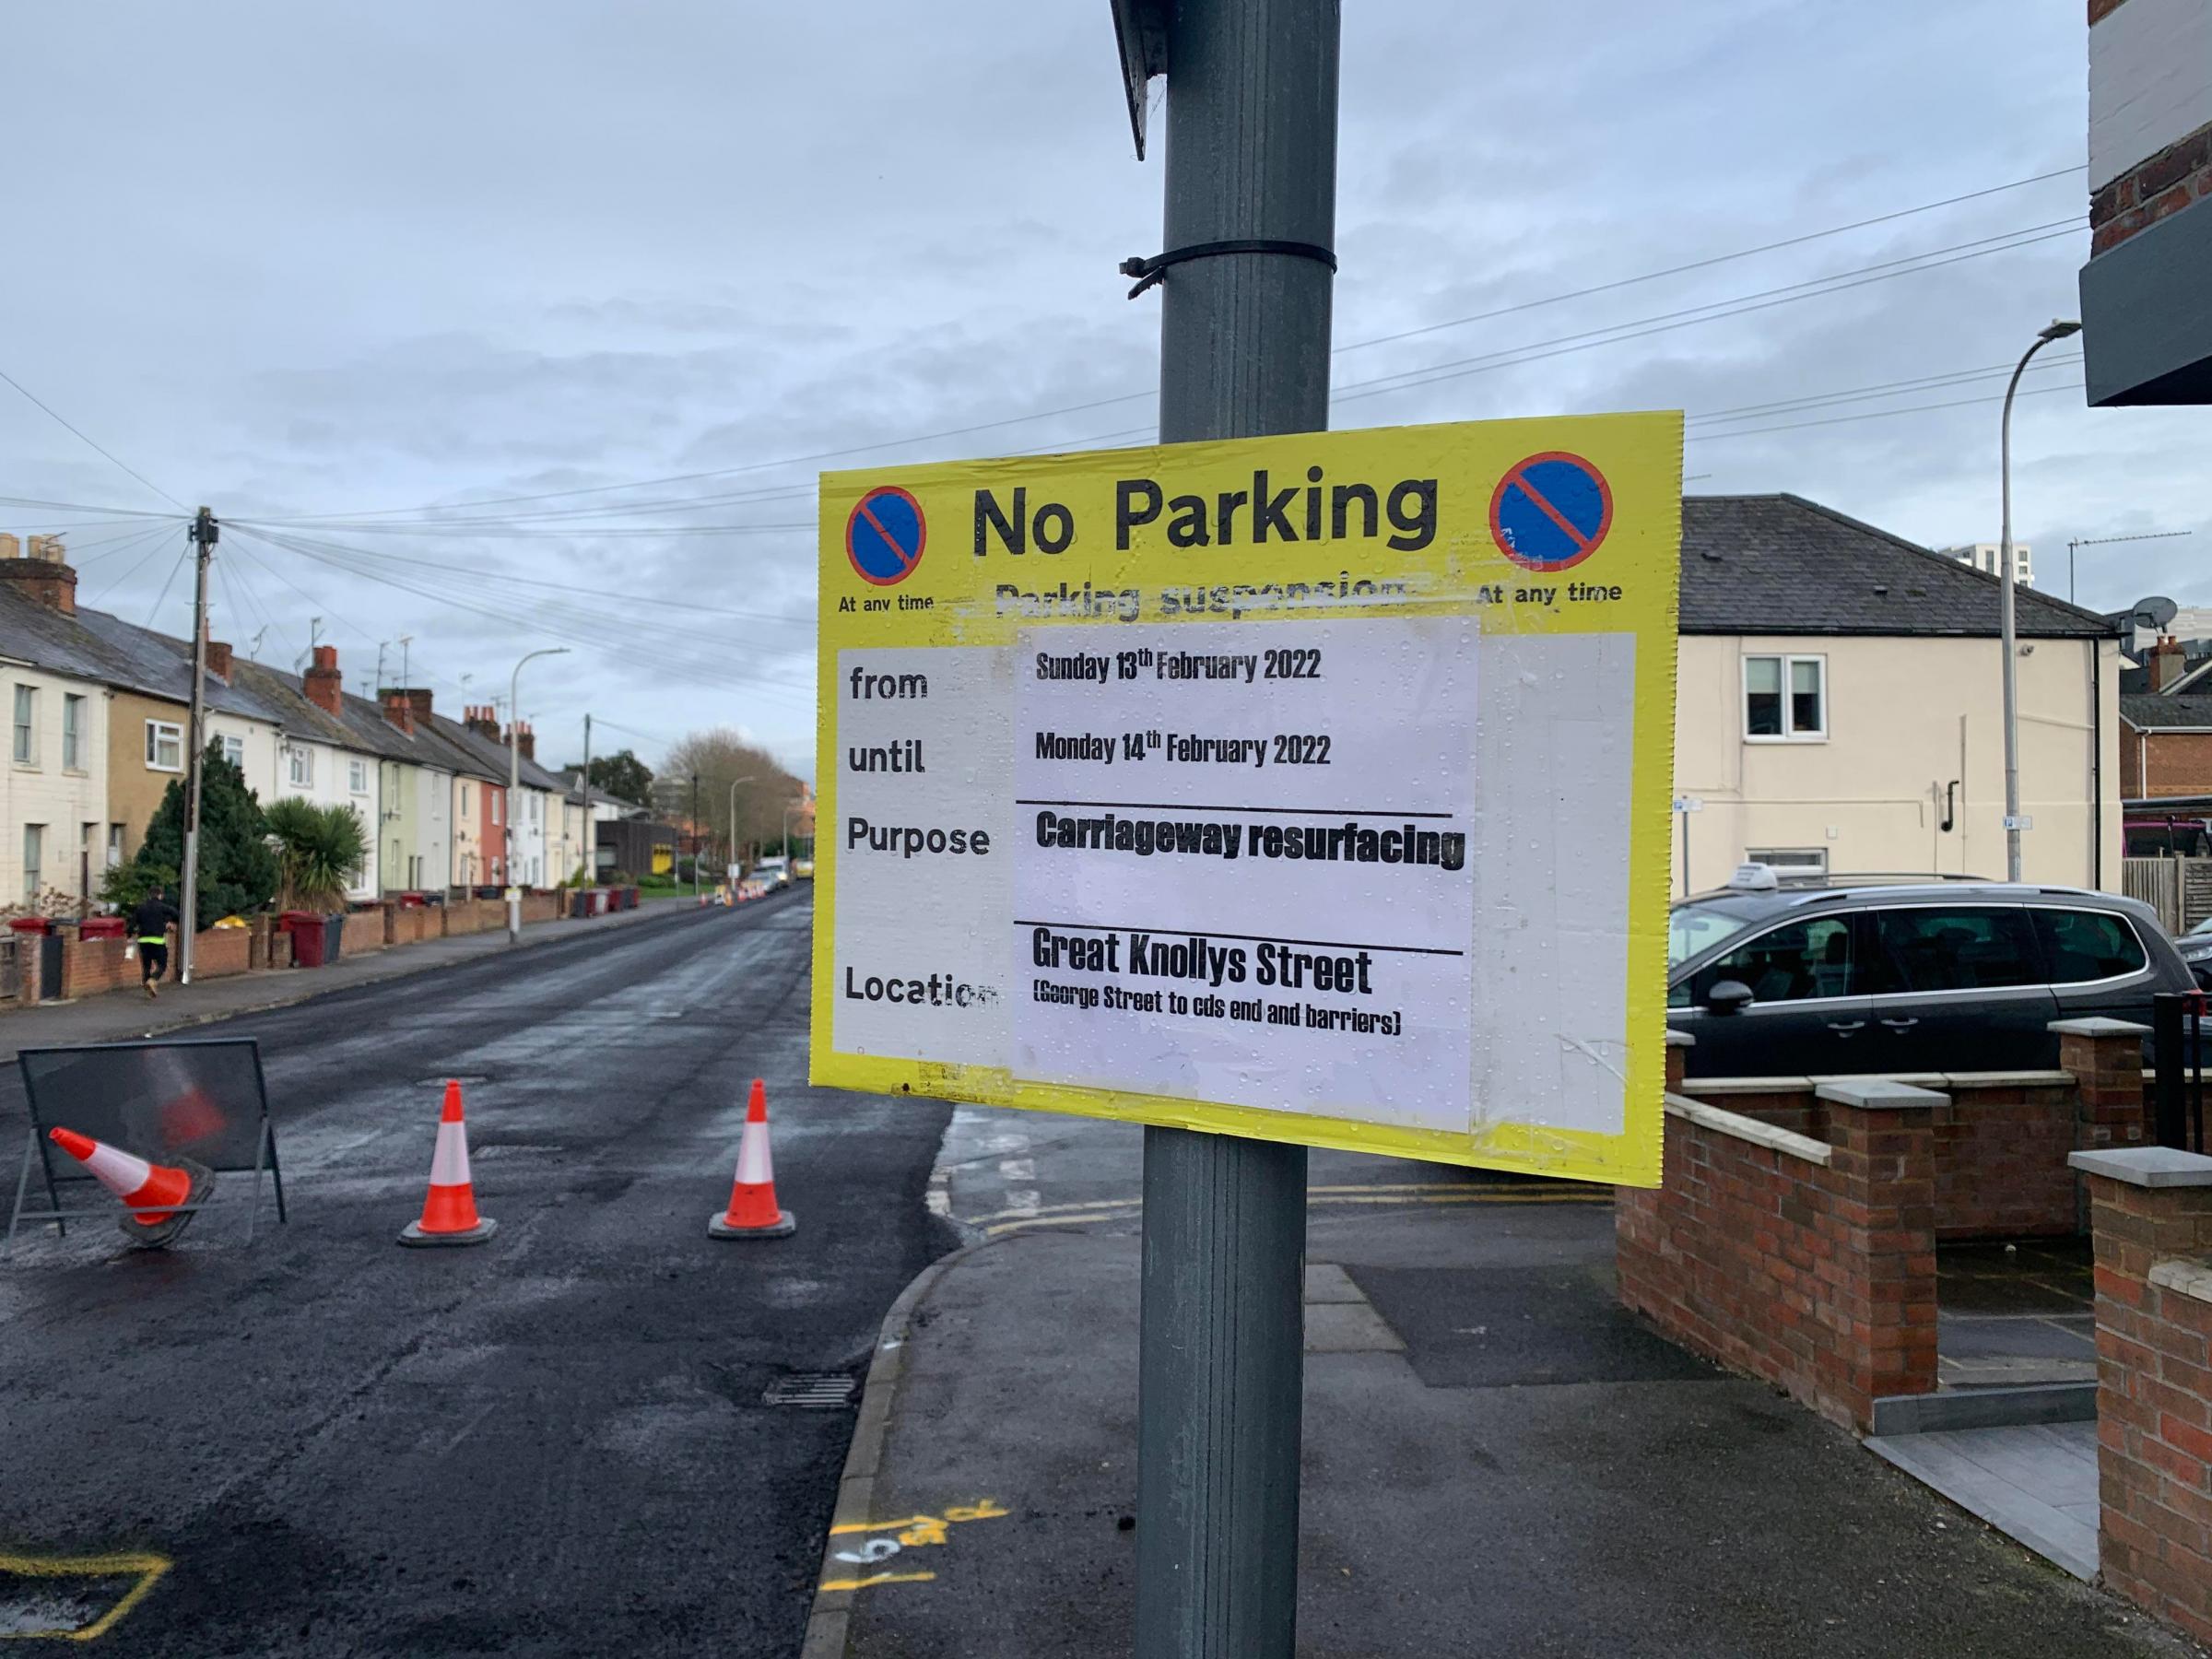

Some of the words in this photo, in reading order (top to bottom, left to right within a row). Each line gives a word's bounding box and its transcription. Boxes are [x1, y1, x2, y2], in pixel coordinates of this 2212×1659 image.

[974, 488, 1074, 556] No
[1116, 465, 1438, 552] Parking
[839, 596, 855, 612] At
[898, 594, 934, 610] time
[1477, 584, 1503, 604] At
[1515, 587, 1557, 606] any
[1568, 582, 1622, 602] time
[850, 667, 928, 700] from
[1036, 653, 1110, 684] Sunday
[1116, 648, 1152, 679] 13th
[1157, 651, 1257, 683] February
[1265, 649, 1321, 678] 2022
[849, 739, 925, 772] until
[1036, 732, 1115, 765] Monday
[1123, 730, 1160, 761] 14th
[1167, 735, 1267, 768] February
[1274, 735, 1331, 764] 2022
[848, 818, 990, 858] Purpose
[1036, 811, 1241, 859] Carriageway
[1249, 823, 1465, 870] resurfacing
[1032, 927, 1119, 973] Great
[1130, 934, 1246, 987] Knollys
[1256, 943, 1373, 994] Street
[1103, 985, 1162, 1013] Street
[1168, 991, 1188, 1015] to
[1193, 994, 1225, 1018] cds
[1230, 999, 1262, 1022] end
[1267, 1003, 1300, 1027] and
